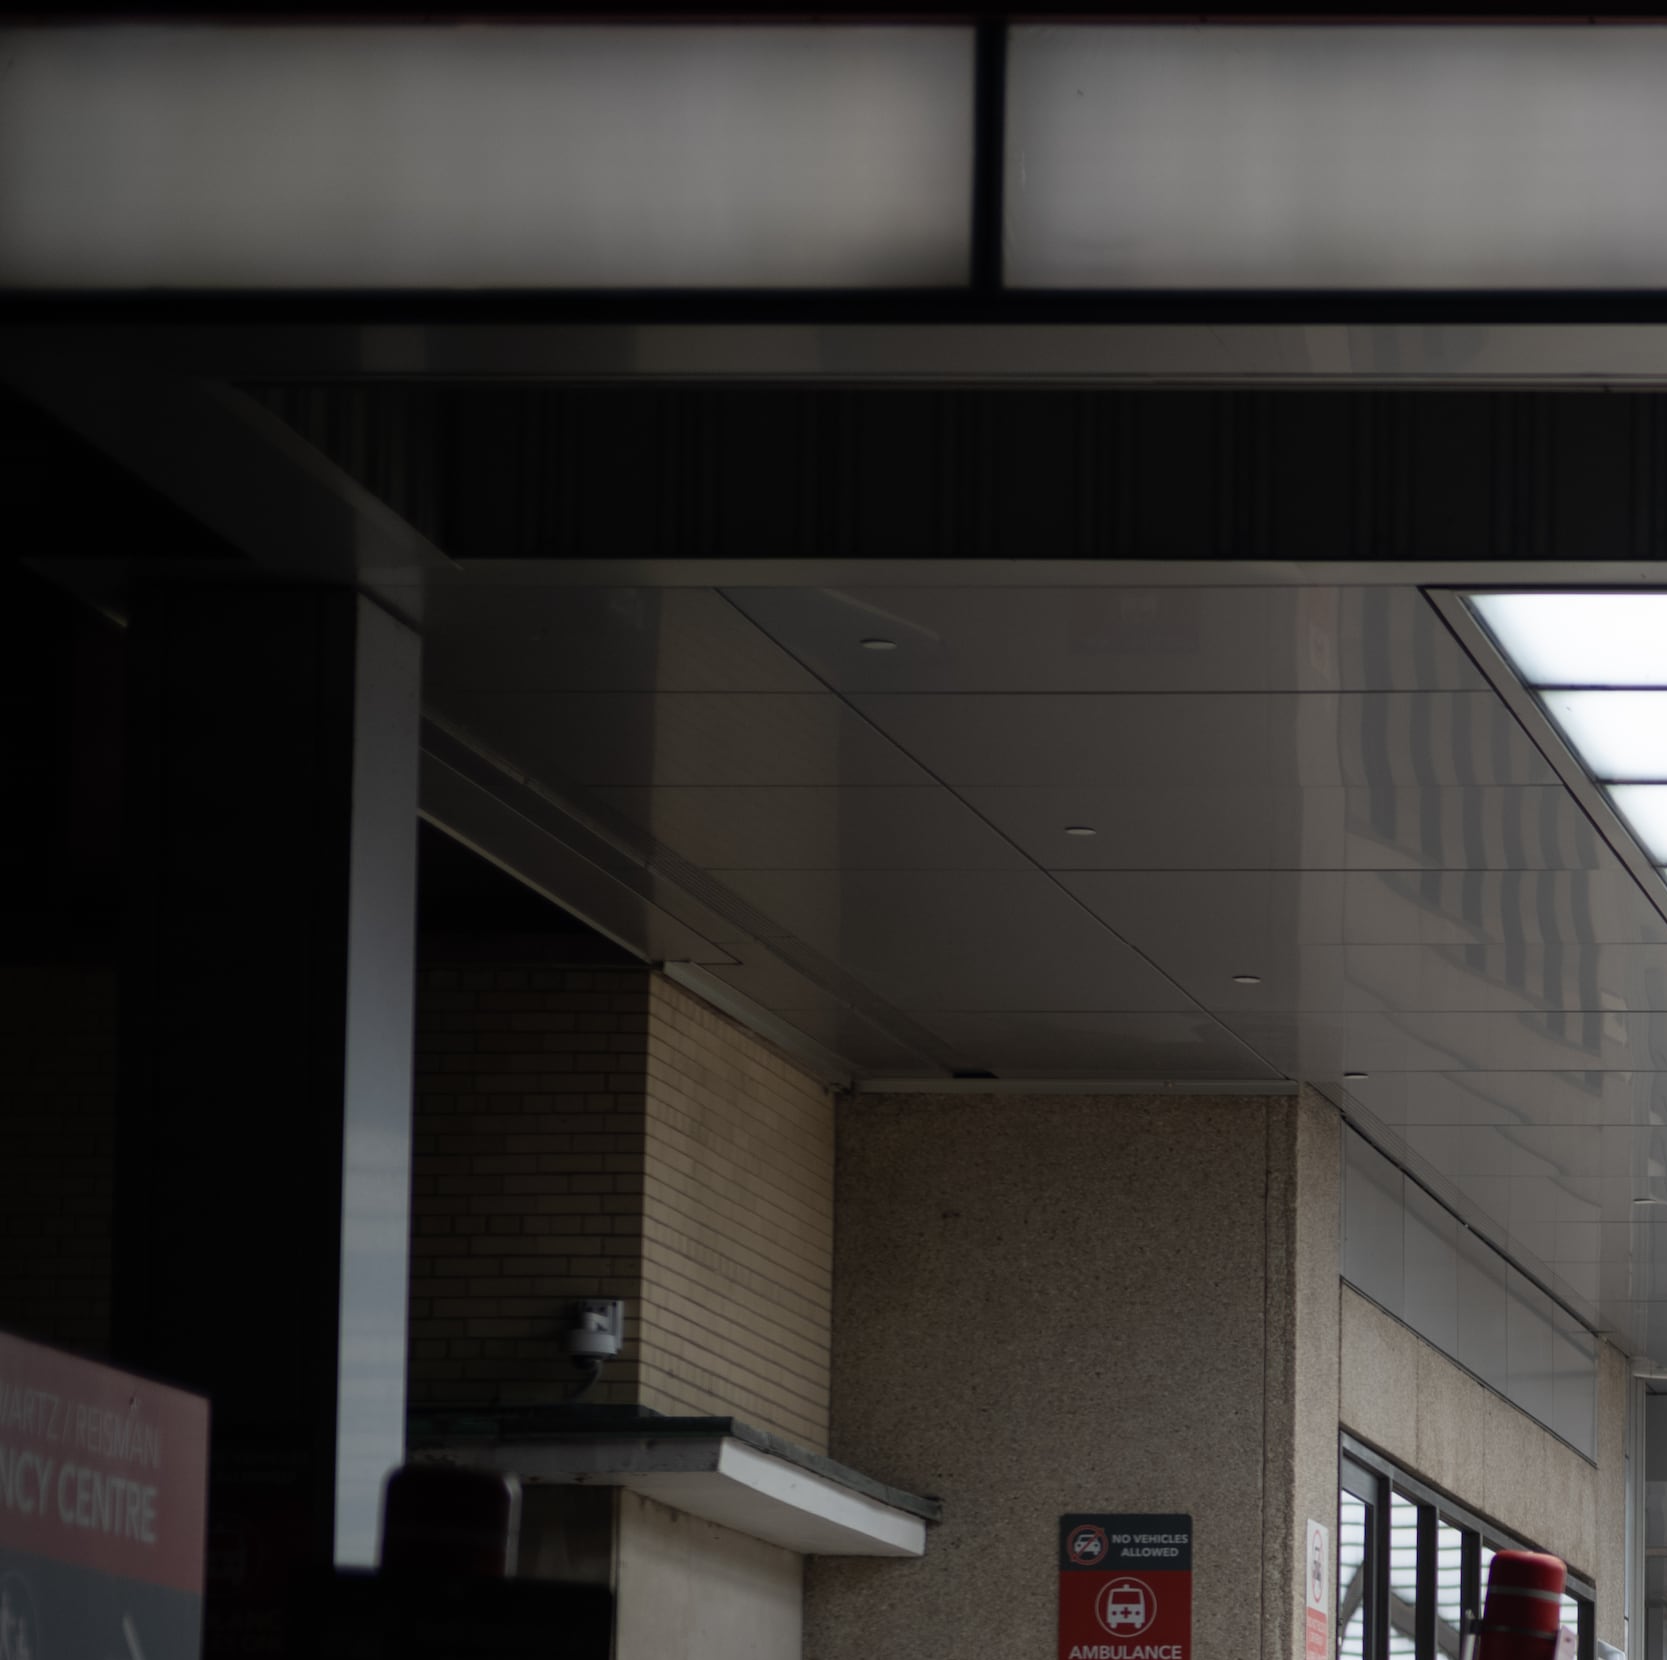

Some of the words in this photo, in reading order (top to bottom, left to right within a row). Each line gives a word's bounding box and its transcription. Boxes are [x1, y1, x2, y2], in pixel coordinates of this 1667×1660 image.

[57, 1462, 157, 1544] CENTRE
[1112, 1534, 1131, 1543] NO
[1133, 1534, 1188, 1543] VEHICLES
[1120, 1548, 1179, 1557] ALLOWED
[1068, 1645, 1183, 1660] AMBULANCE
